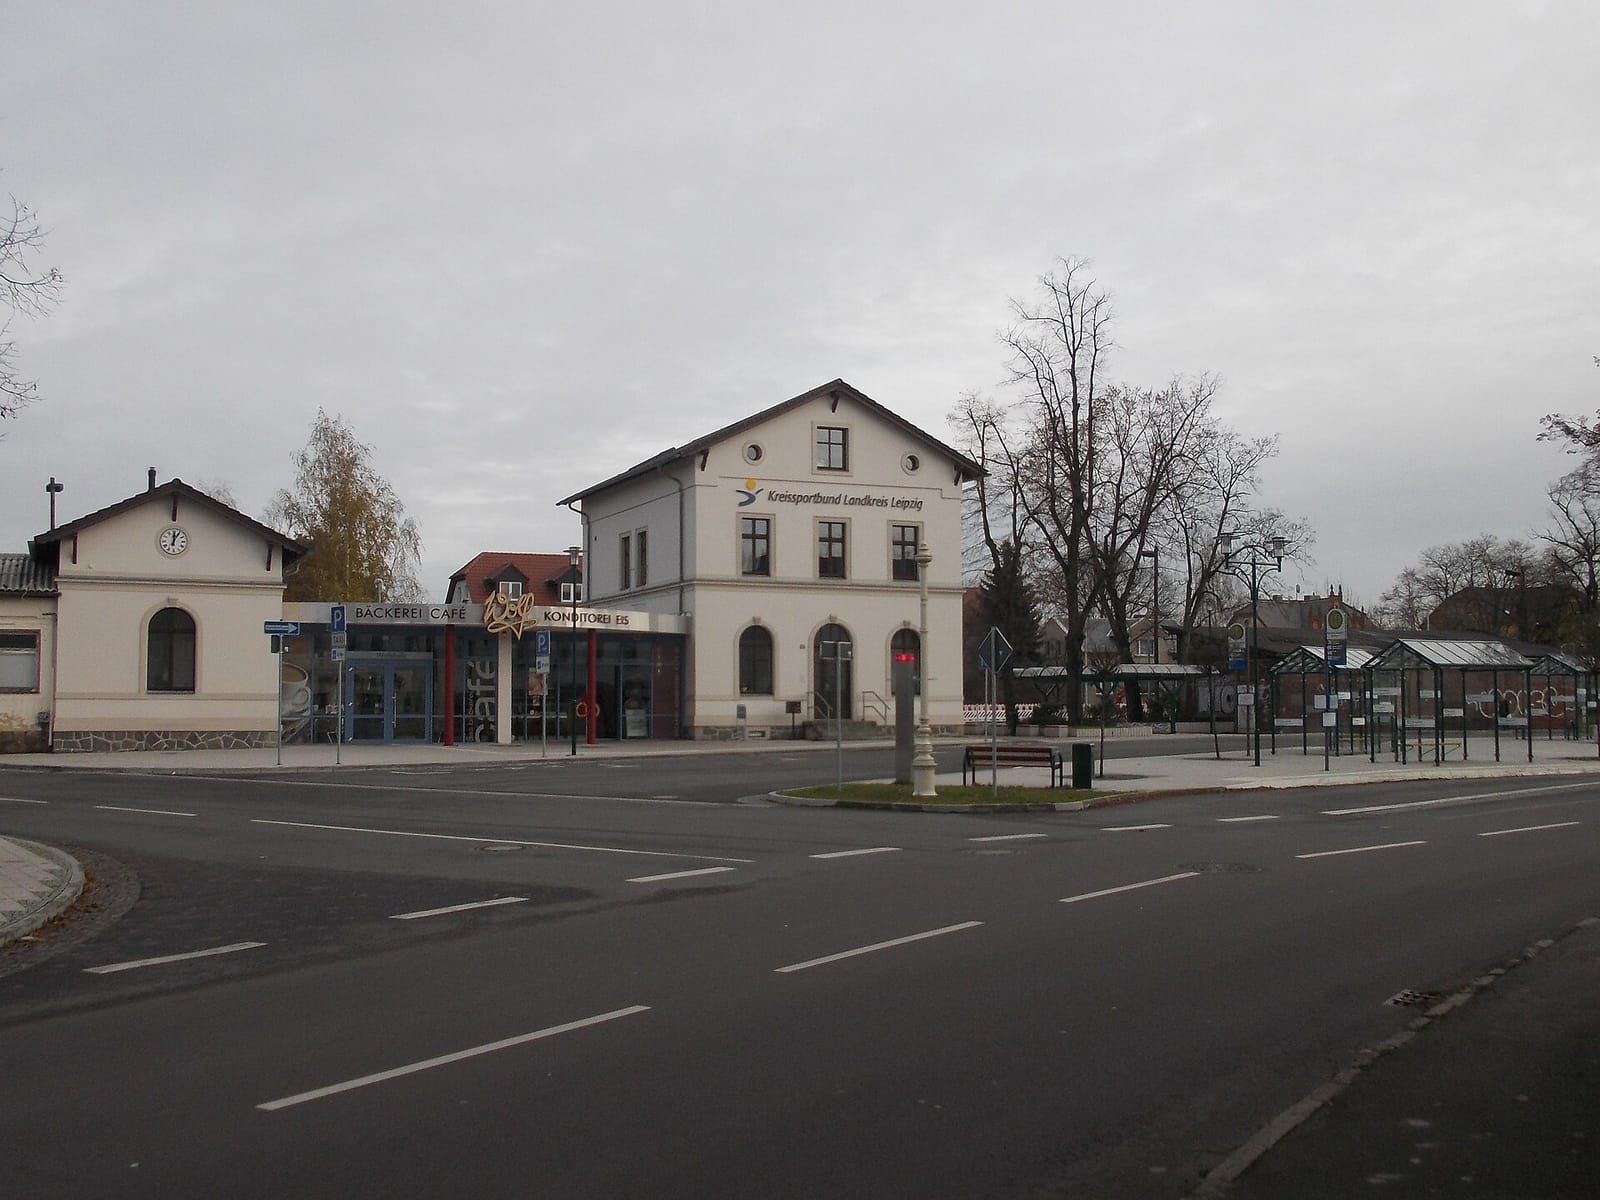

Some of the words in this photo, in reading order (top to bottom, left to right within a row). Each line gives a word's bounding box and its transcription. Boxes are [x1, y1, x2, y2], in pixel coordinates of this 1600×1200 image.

[767, 490, 841, 506] Kreissportbund
[843, 493, 889, 508] Landkreis
[890, 496, 924, 512] Leipzig
[333, 609, 342, 629] P
[355, 605, 422, 619] BÄCKEREI
[430, 606, 466, 619] CAFÉ
[544, 611, 611, 624] KONDITOREI
[616, 614, 630, 625] EIS
[466, 660, 496, 743] café
